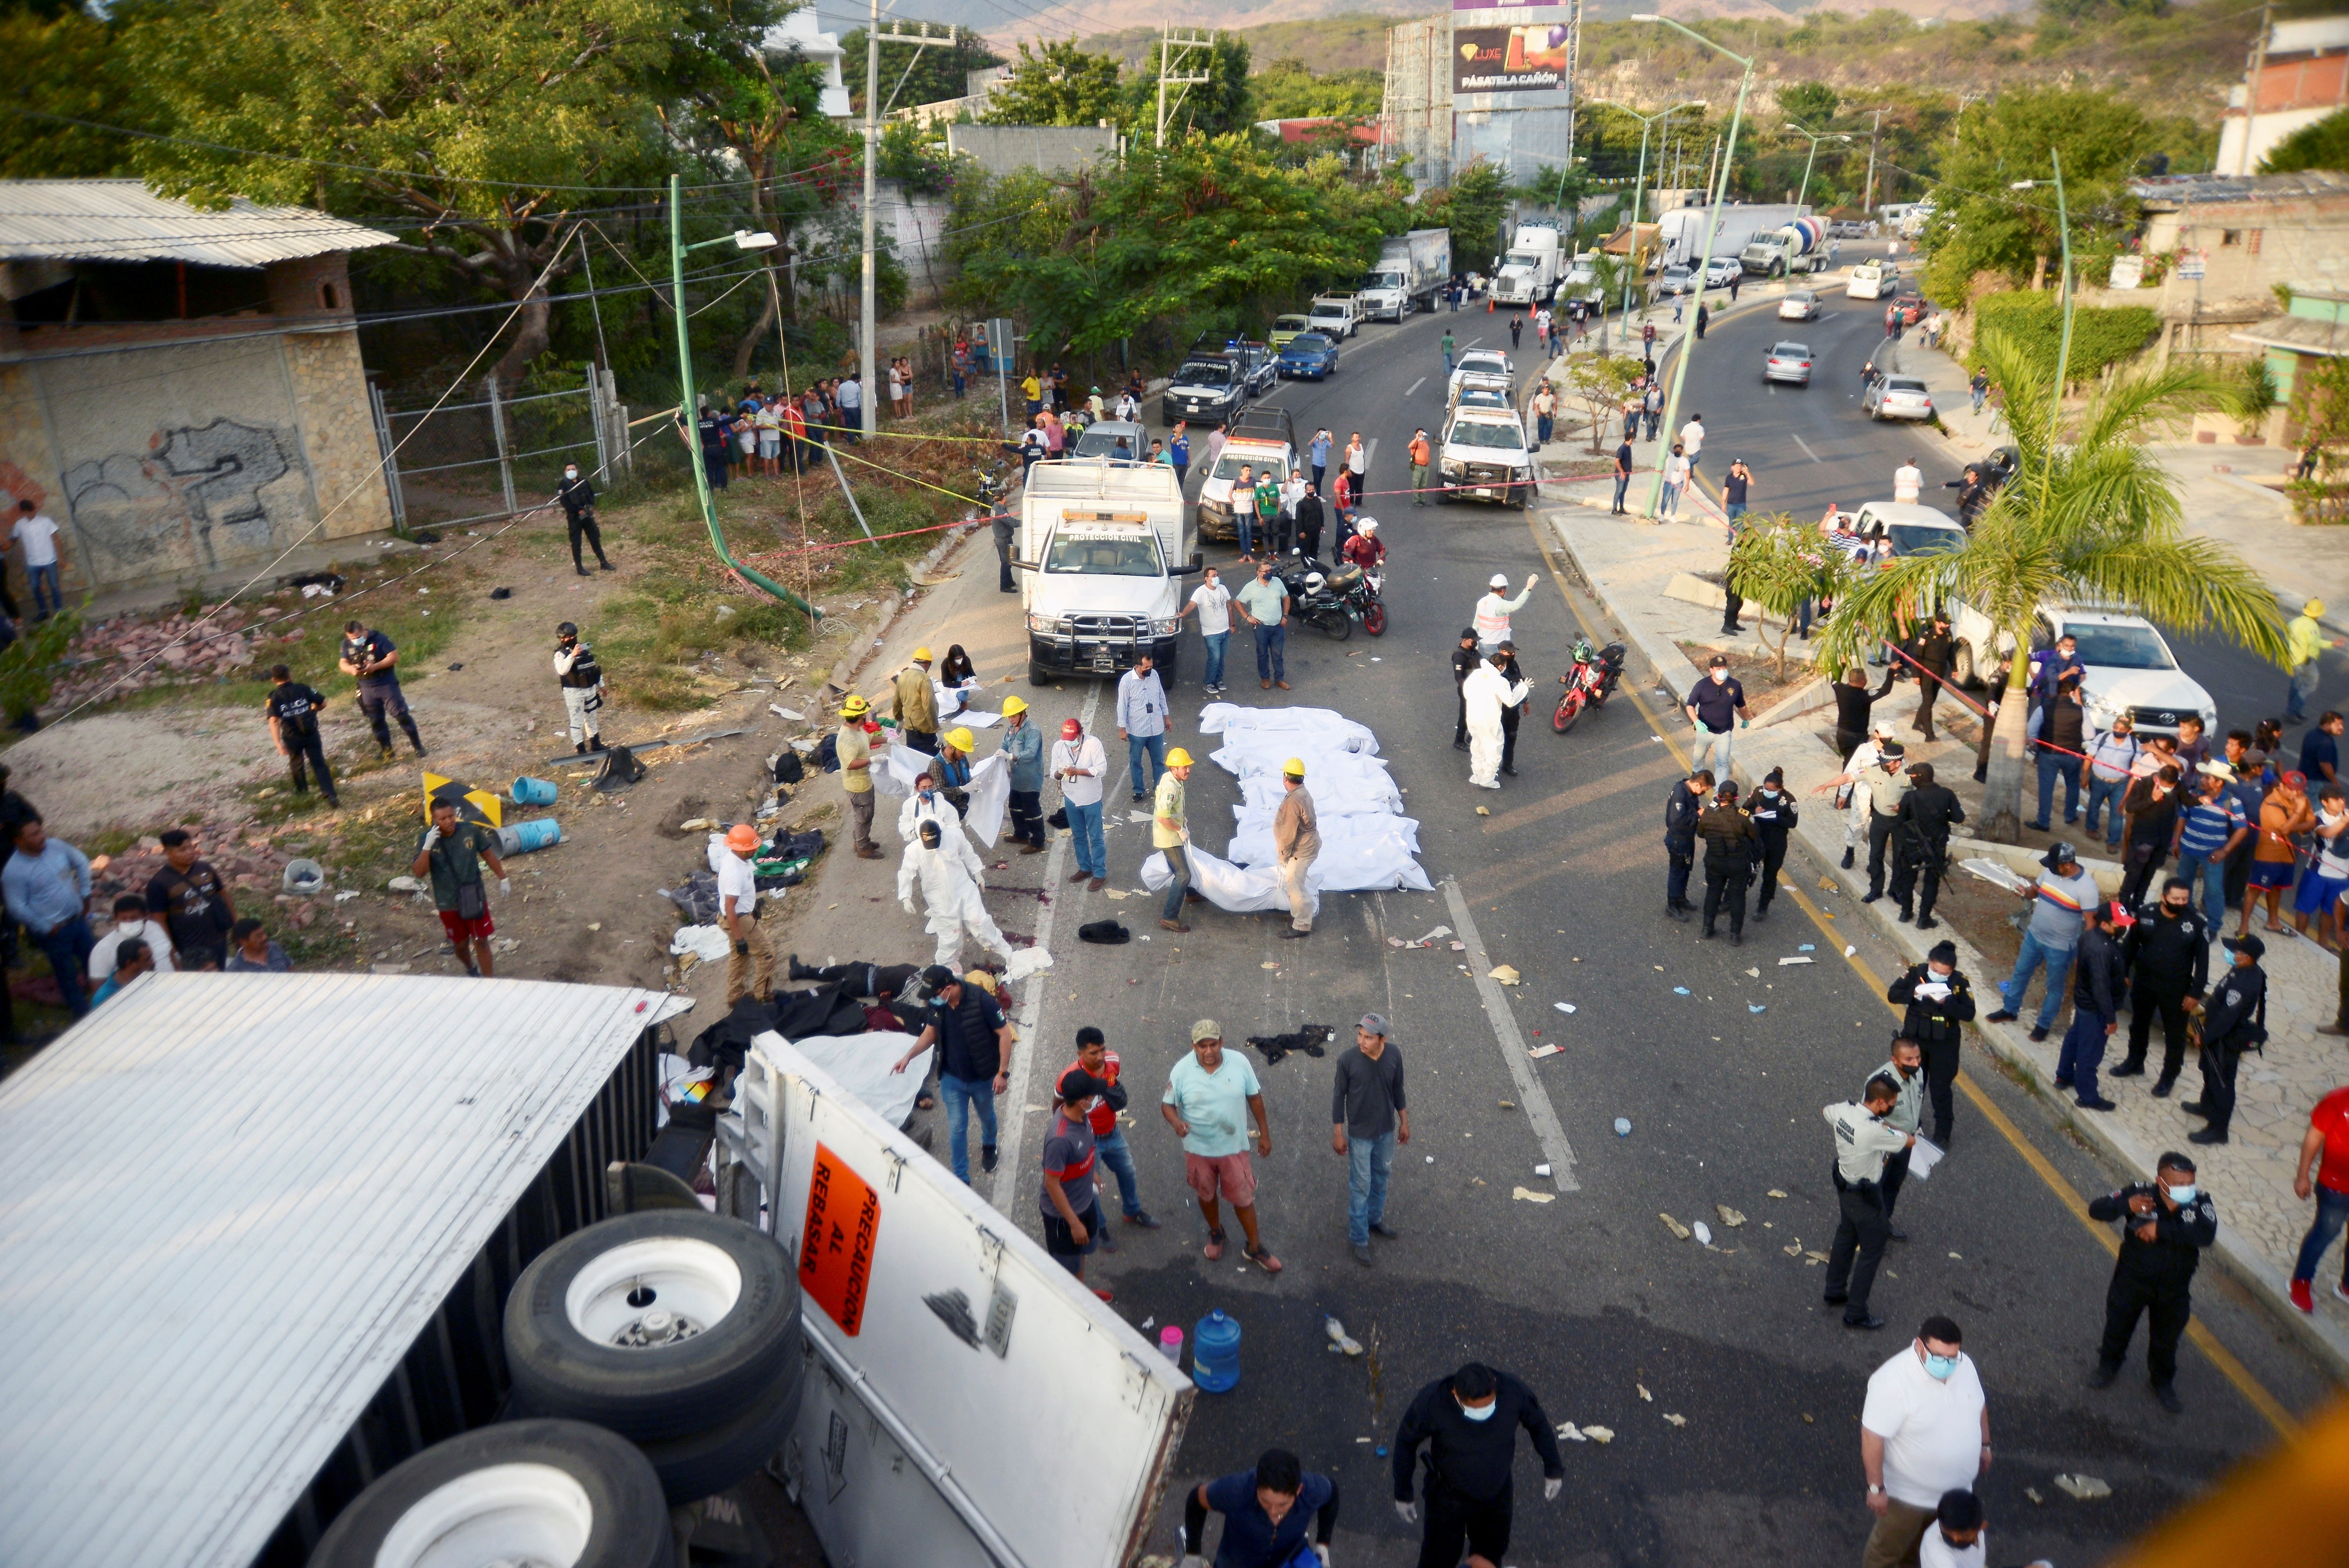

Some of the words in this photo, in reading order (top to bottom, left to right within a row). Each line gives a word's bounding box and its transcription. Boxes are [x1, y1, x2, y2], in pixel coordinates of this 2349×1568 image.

[1518, 72, 1558, 86] CAÑÓN
[1836, 1125, 1855, 1146] NACIONAL
[1837, 1118, 1855, 1136] GUARDIA
[802, 1161, 831, 1275] REBASAR
[829, 1220, 844, 1255] AL
